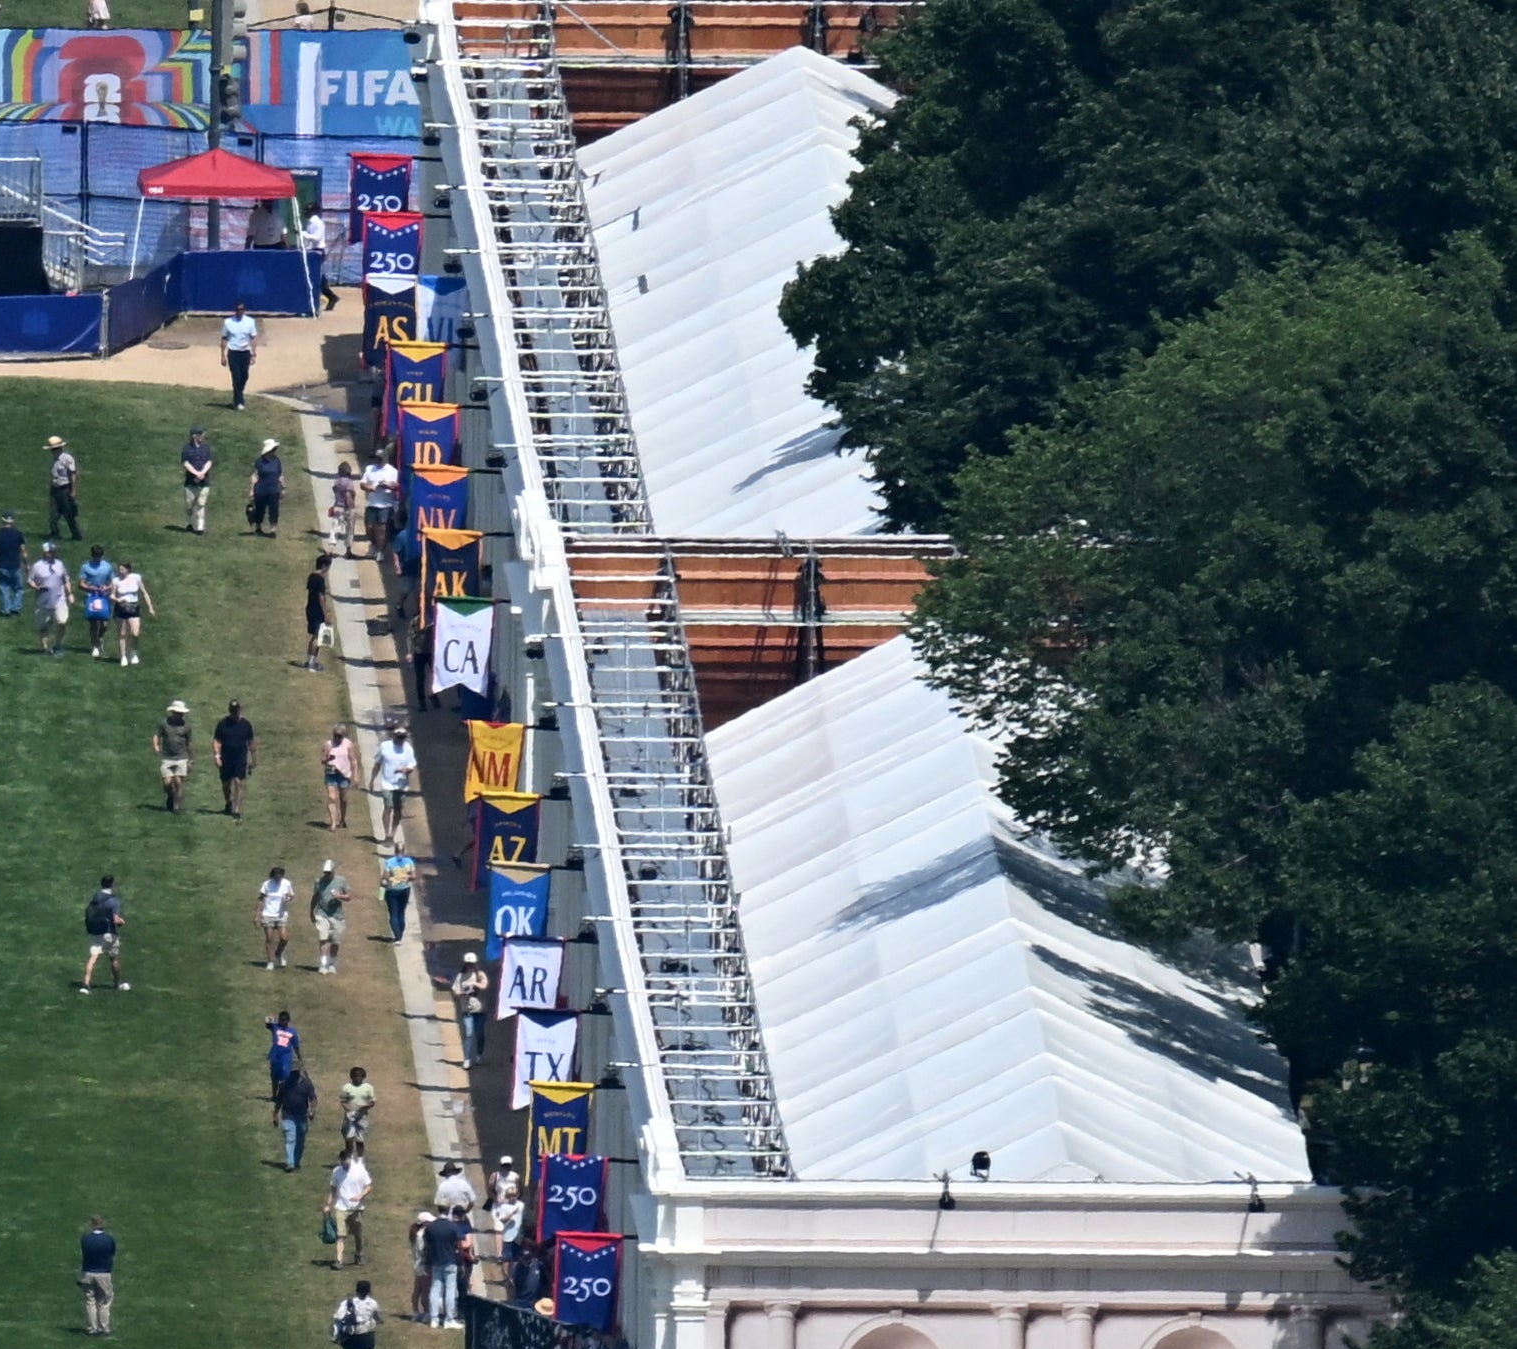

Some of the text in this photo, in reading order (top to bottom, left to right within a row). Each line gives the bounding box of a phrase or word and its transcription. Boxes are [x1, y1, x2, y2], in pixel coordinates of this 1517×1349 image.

[320, 70, 420, 105] FIFA
[357, 194, 402, 213] 250
[370, 251, 414, 275] 250
[375, 315, 410, 349] AS
[414, 442, 442, 465] ID
[418, 506, 457, 541] NV
[434, 571, 468, 598] AK
[443, 639, 479, 675] CA
[469, 751, 512, 787] NM
[495, 905, 536, 936] OK
[508, 965, 548, 1004] AR
[525, 1051, 565, 1082] TX
[538, 1126, 582, 1156] MT
[549, 1185, 597, 1212] 250
[563, 1276, 611, 1302] 250
